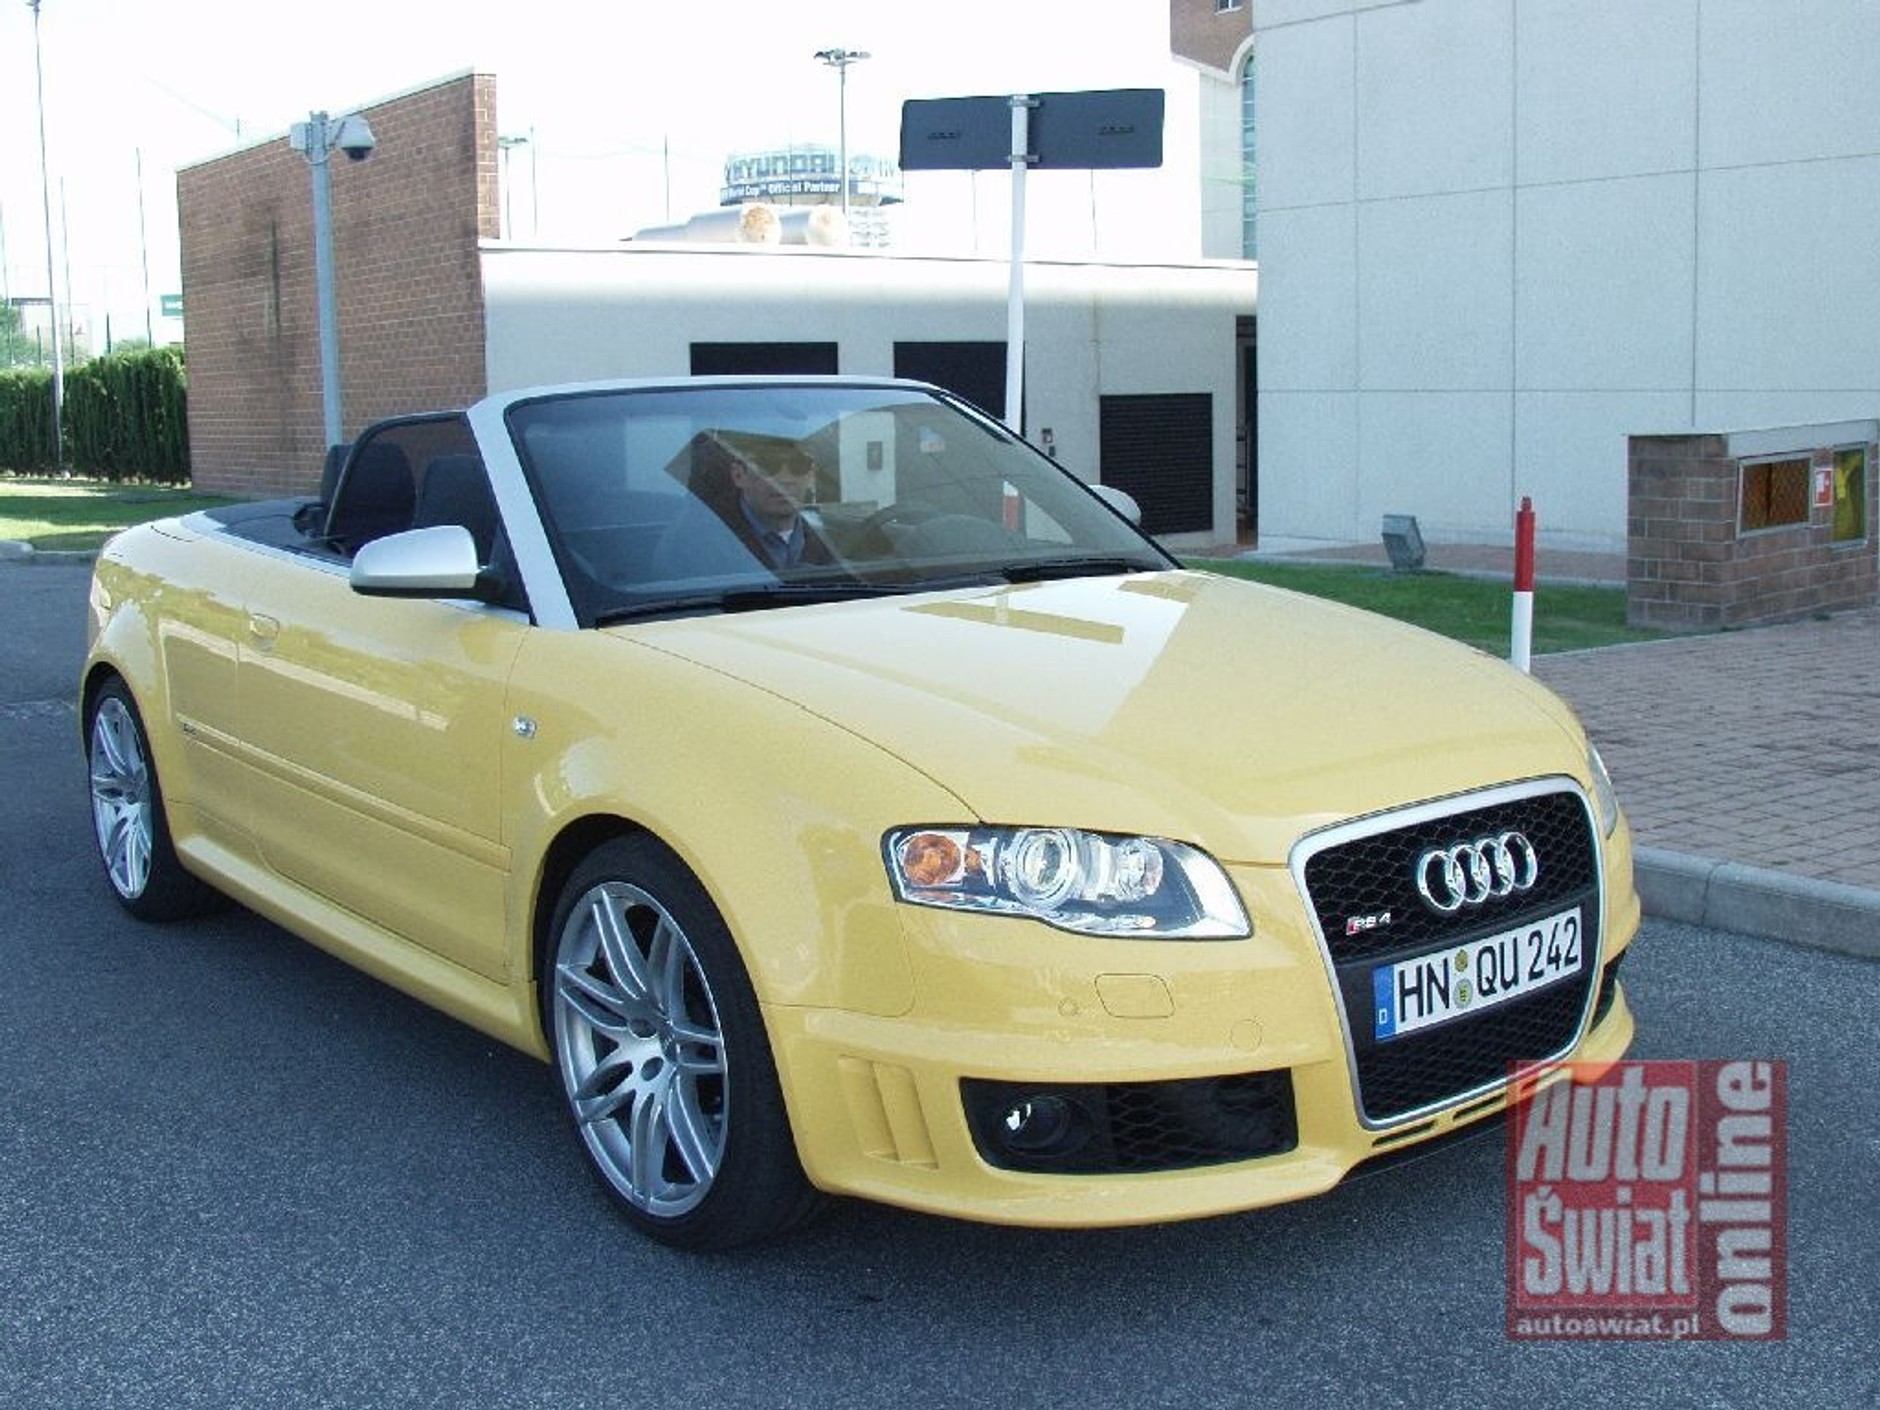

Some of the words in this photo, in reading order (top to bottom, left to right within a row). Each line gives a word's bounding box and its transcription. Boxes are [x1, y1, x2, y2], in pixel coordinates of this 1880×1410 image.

[804, 181, 839, 193] Partner
[1400, 957, 1450, 1022] HN
[1476, 937, 1519, 998] QU
[1528, 915, 1579, 980] 242
